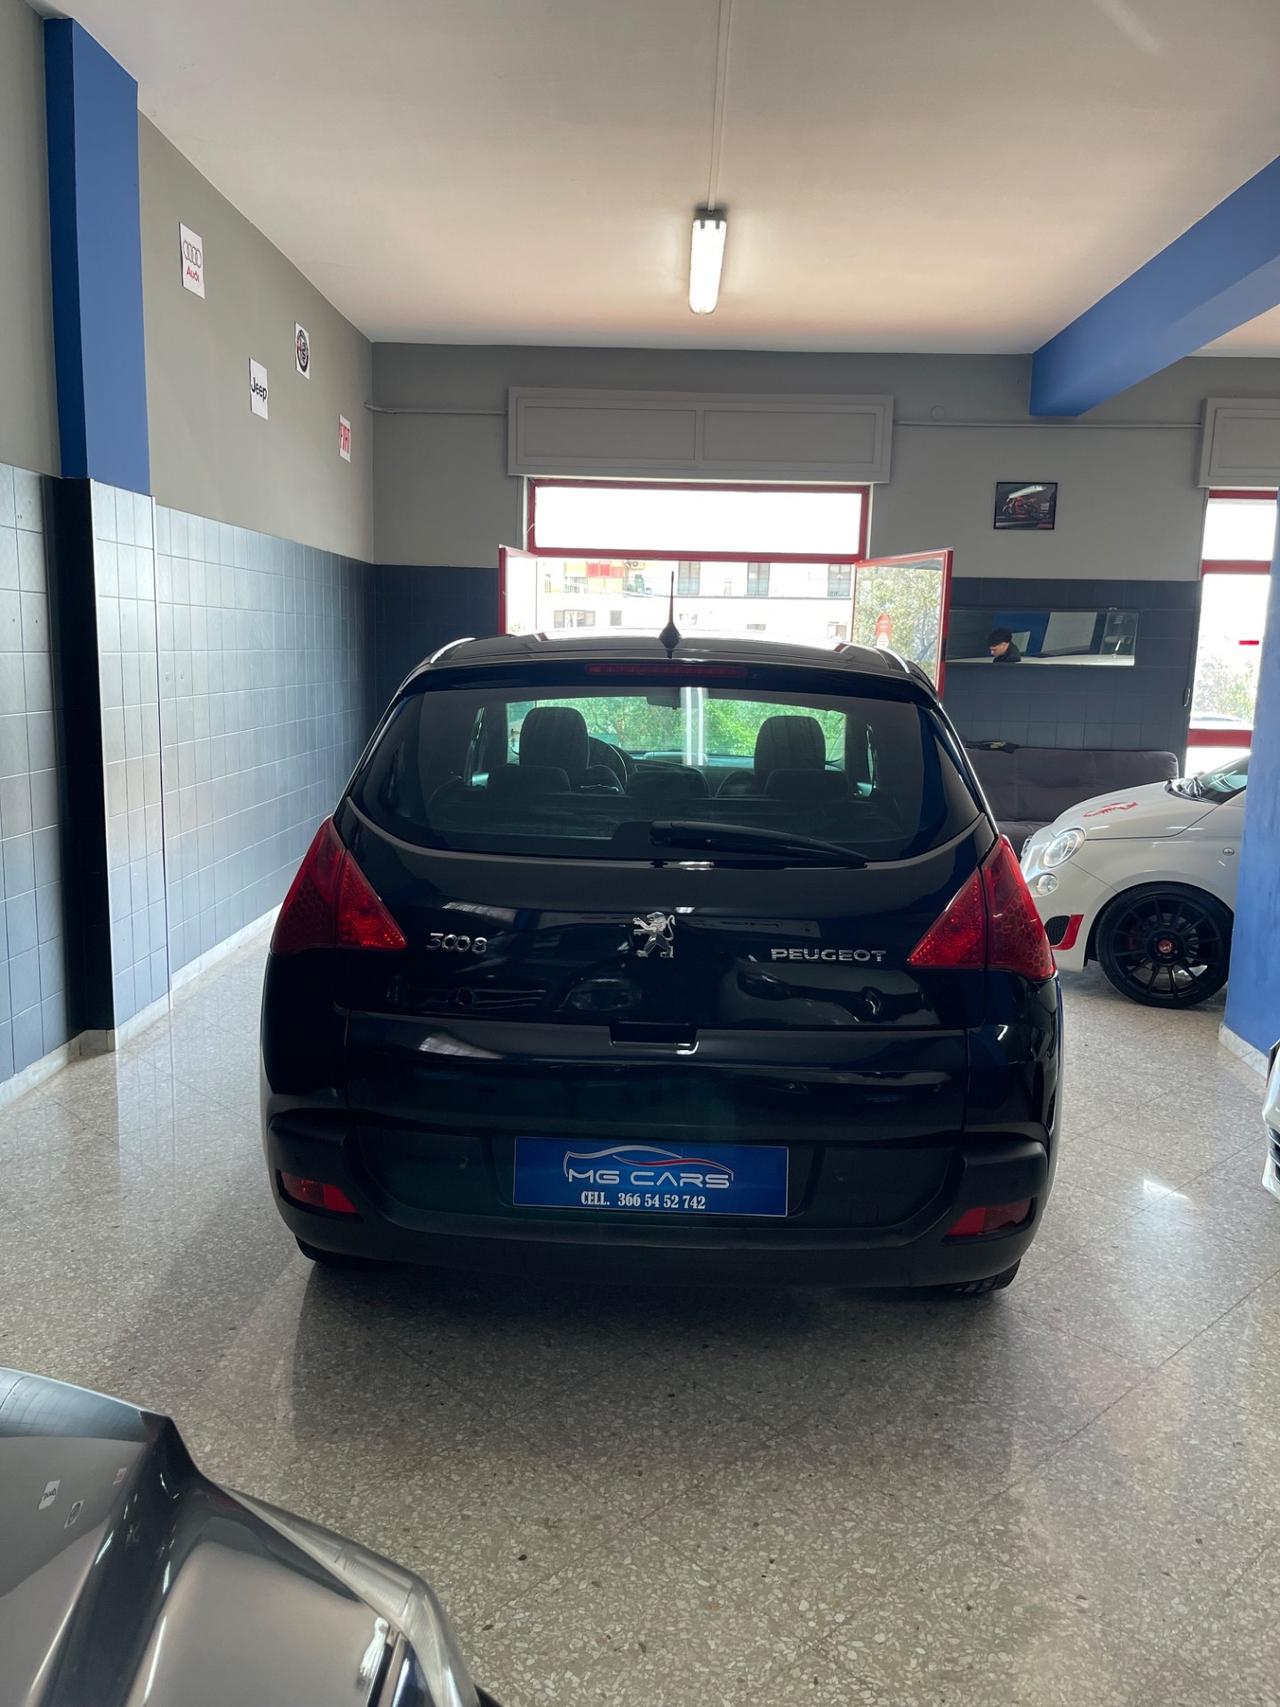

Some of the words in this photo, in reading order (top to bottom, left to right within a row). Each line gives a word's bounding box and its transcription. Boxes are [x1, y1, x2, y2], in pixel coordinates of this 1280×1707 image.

[186, 265, 200, 283] Audi
[251, 376, 267, 402] Jeep
[426, 932, 488, 954] 3008
[770, 948, 887, 962] PEUGEOT
[568, 1168, 620, 1185] MG
[630, 1171, 730, 1189] CARS
[581, 1190, 610, 1206] CELL.
[618, 1192, 641, 1207] 366
[644, 1193, 660, 1208] 54
[663, 1194, 679, 1209] 52
[682, 1195, 706, 1210] 742
